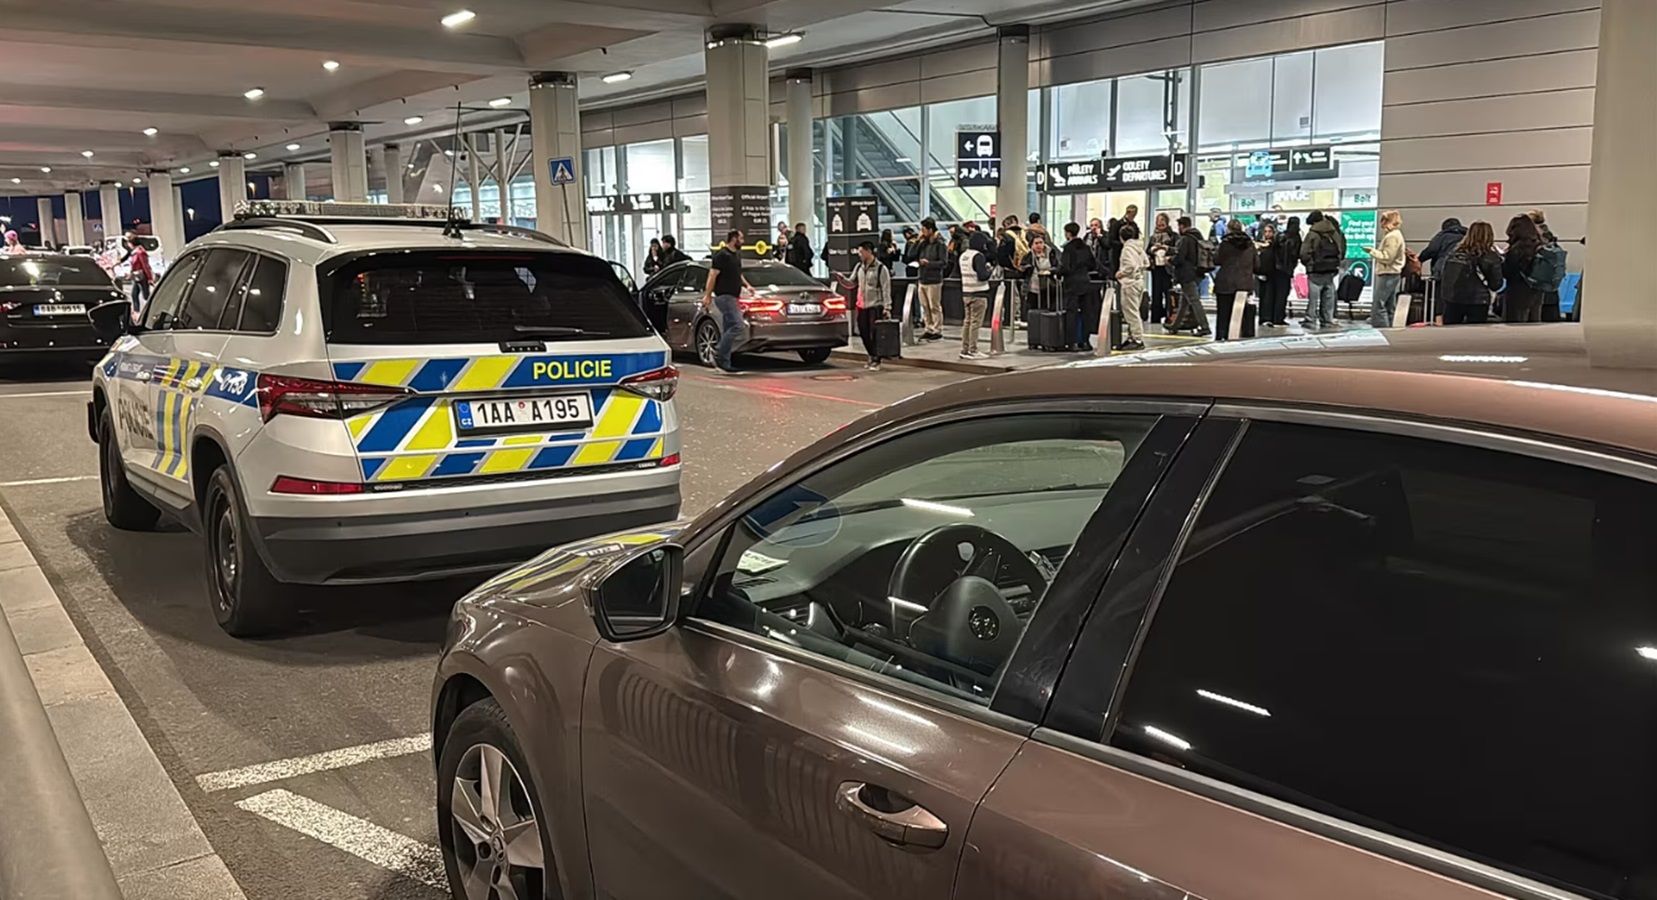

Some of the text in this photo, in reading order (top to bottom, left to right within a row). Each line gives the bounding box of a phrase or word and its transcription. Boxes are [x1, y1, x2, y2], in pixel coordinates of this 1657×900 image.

[1175, 161, 1184, 175] D
[1037, 171, 1045, 185] D
[1067, 174, 1098, 186] ARRIVALS
[1122, 170, 1168, 182] DEPARTURES
[609, 196, 615, 211] 2
[1354, 193, 1371, 203] Bolt
[532, 360, 612, 380] POLICIE
[477, 398, 580, 425] 1AA A195
[461, 418, 472, 426] CZ
